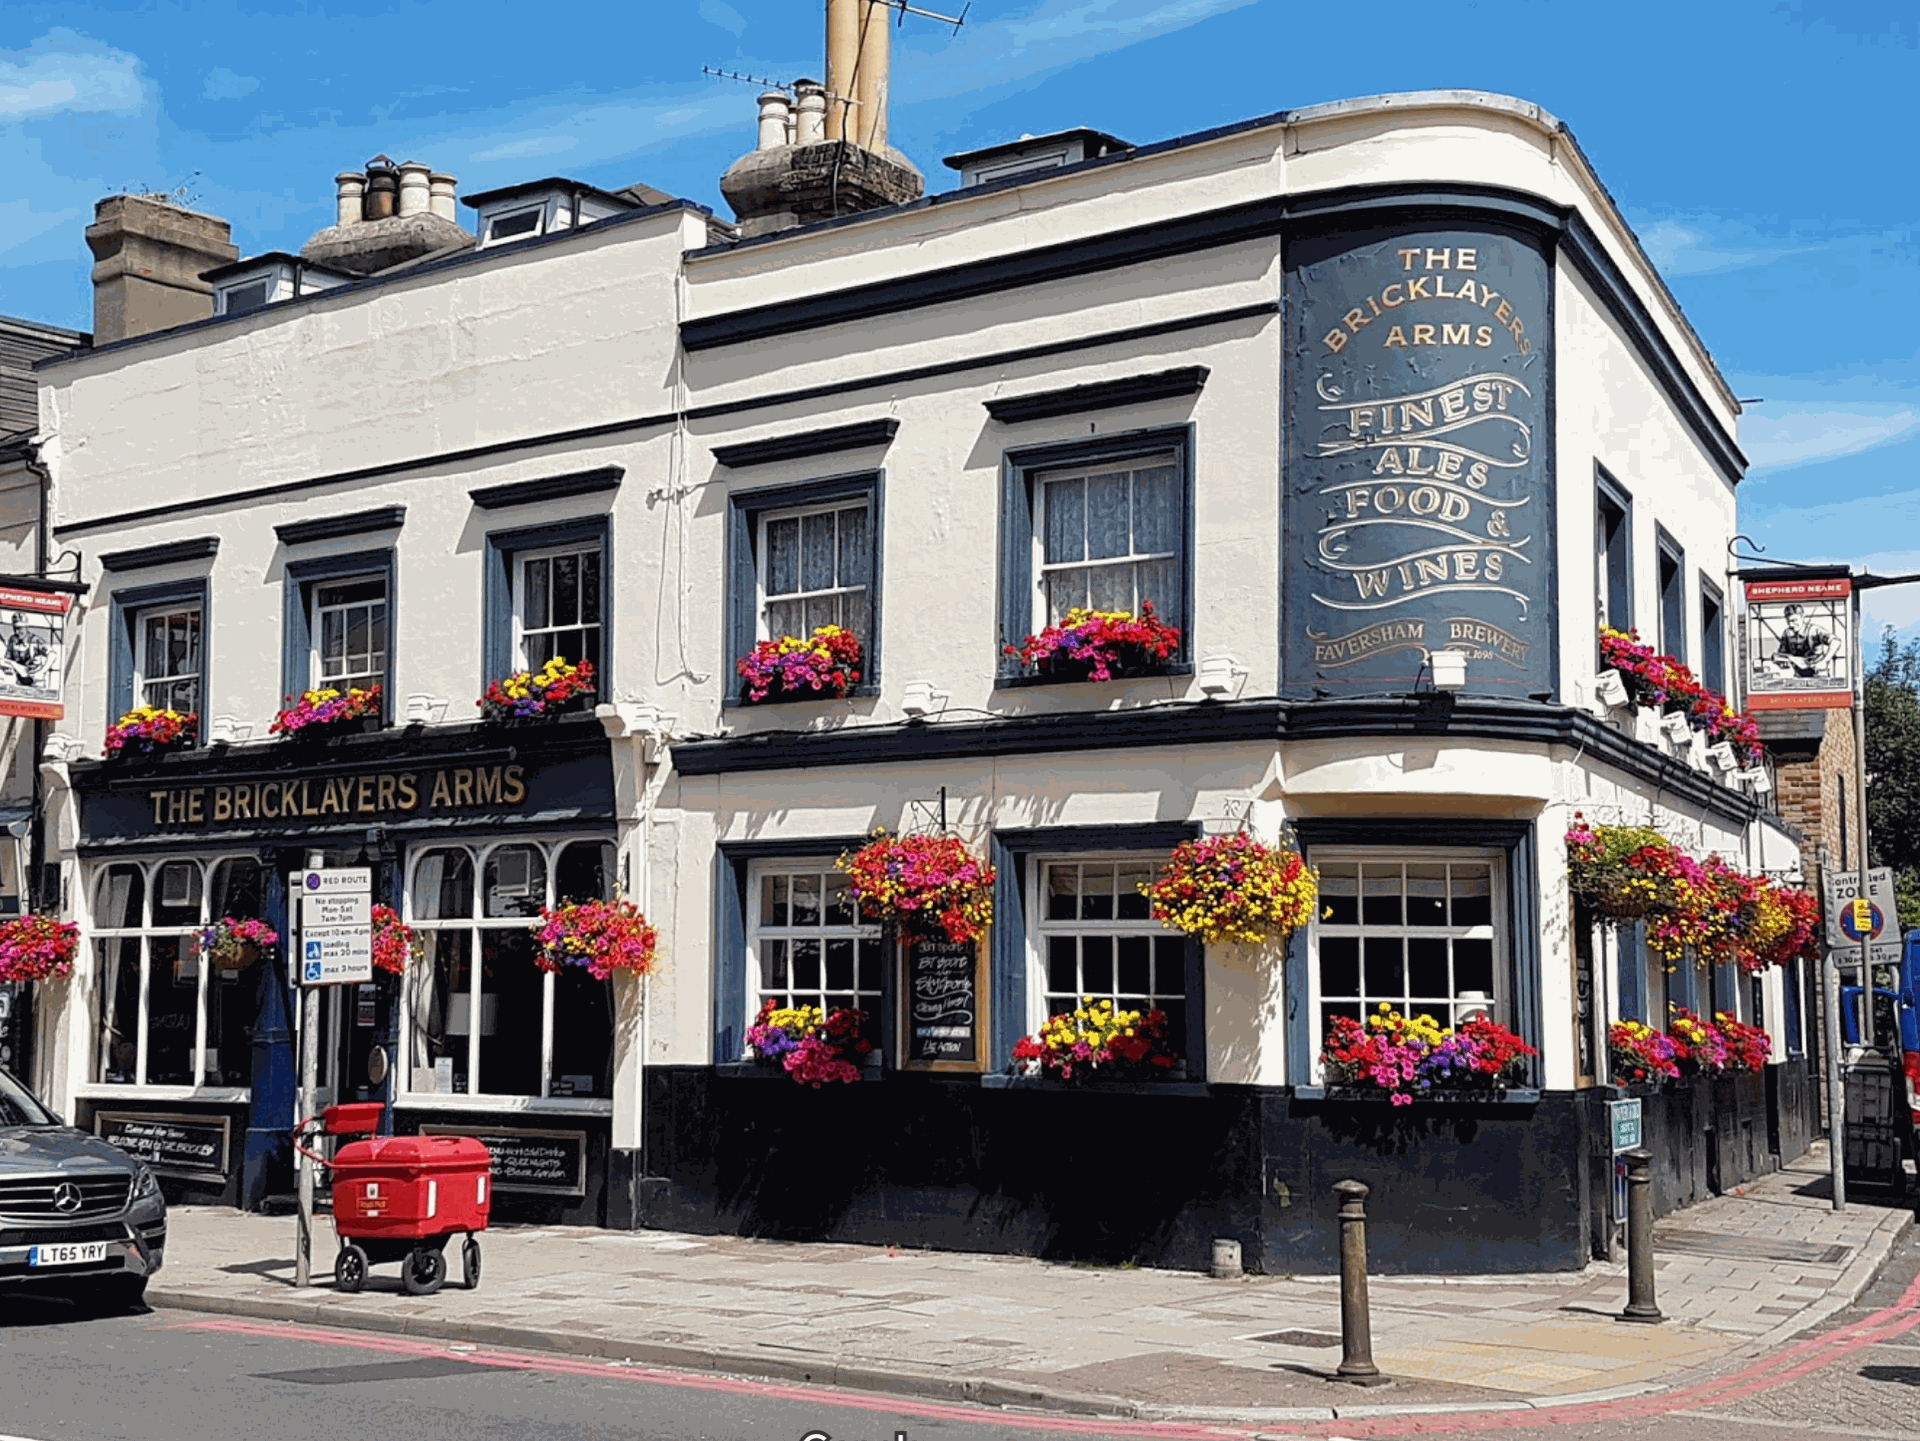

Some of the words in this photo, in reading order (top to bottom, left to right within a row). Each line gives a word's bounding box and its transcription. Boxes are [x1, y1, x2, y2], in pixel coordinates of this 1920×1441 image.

[1398, 248, 1477, 271] THE
[1322, 275, 1532, 356] BRICKLAYERS
[1383, 323, 1493, 347] ARMS
[1349, 382, 1513, 436] FINEST
[1372, 447, 1488, 489] ALES
[1346, 485, 1470, 522] FOOD
[1486, 508, 1510, 537] &
[1353, 552, 1503, 599] WINES
[1752, 585, 1805, 595] SHEPHERD
[1807, 584, 1842, 593] NEAME
[1314, 623, 1425, 661] FAVERSHAM
[1450, 623, 1530, 661] BREWERY
[151, 788, 205, 826] THE
[214, 775, 418, 820] BRICKLAYERS
[430, 764, 526, 808] ARMS
[323, 877, 339, 885] RED
[341, 875, 367, 884] ROUTE
[1836, 884, 1878, 899] ZOE
[41, 1247, 77, 1262] LT65
[81, 1244, 104, 1259] YRY
